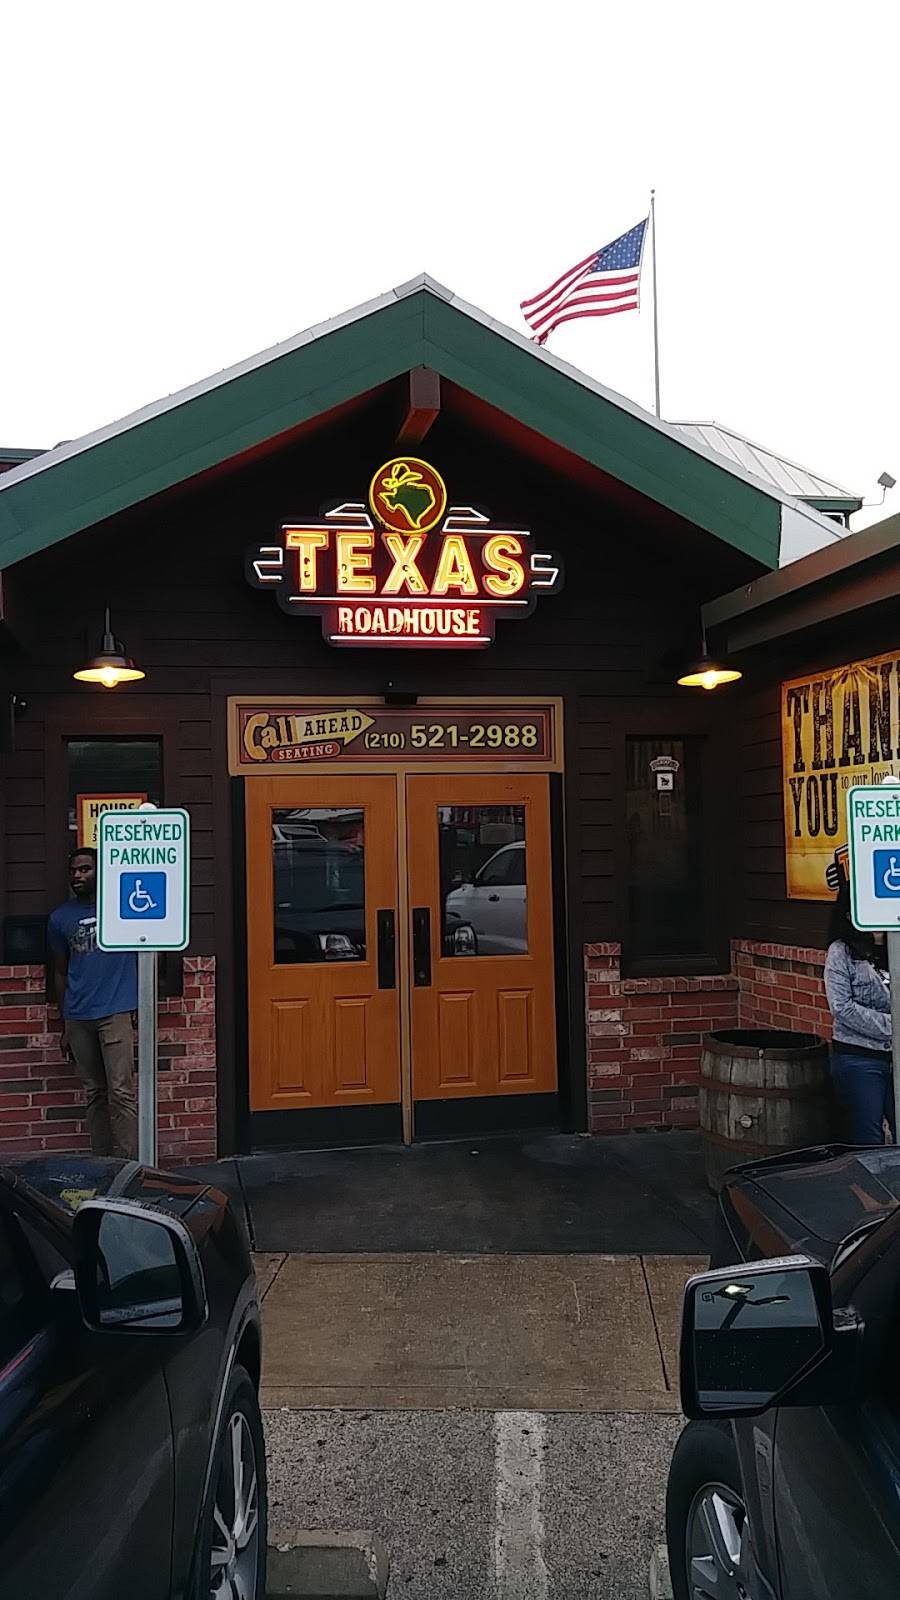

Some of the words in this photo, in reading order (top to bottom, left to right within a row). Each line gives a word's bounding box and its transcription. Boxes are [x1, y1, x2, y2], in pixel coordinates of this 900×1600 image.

[286, 530, 525, 597] TEXAS
[338, 607, 481, 635] ROADHOUSE
[787, 660, 900, 773] THAN
[244, 712, 300, 760] Call
[303, 715, 363, 737] AHEAD
[364, 733, 405, 749] (210)
[410, 725, 538, 748] 521-2988
[278, 744, 334, 761] SEATING
[788, 773, 838, 837] YOU
[105, 823, 182, 841] RESERVED
[110, 847, 177, 865] PARKING
